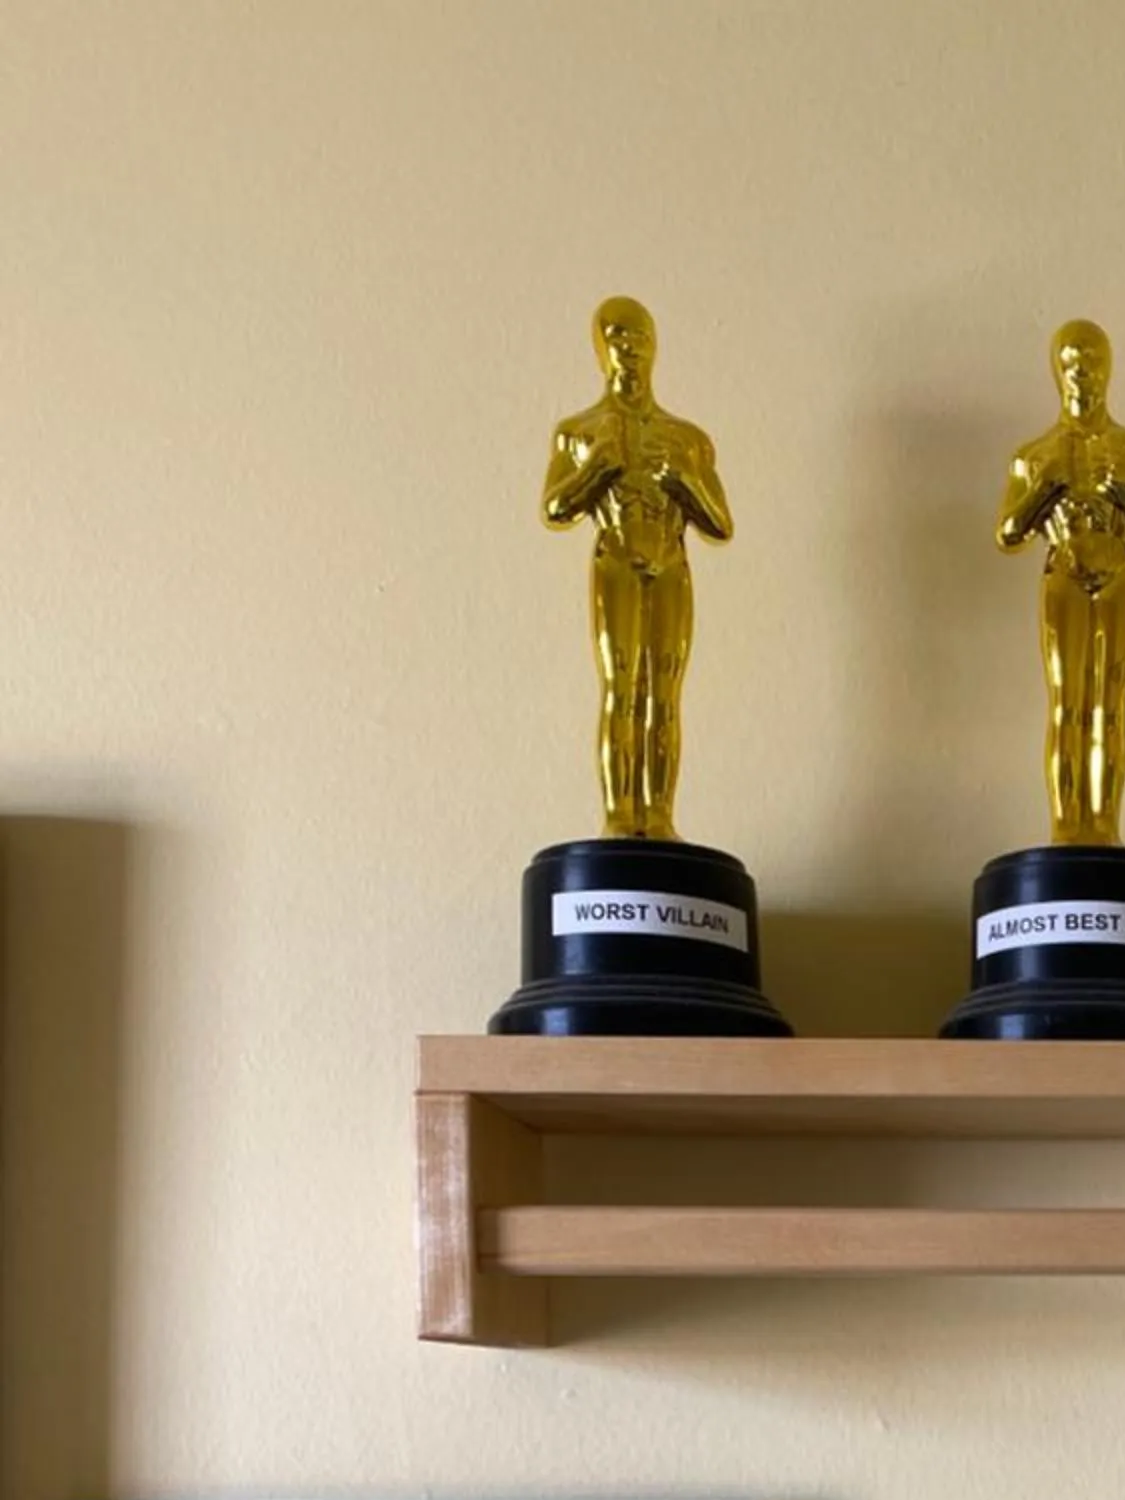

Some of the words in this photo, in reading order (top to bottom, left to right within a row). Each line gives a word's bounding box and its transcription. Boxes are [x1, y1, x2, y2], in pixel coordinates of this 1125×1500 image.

[575, 902, 649, 922] WORST
[656, 904, 729, 934] VILLAIN
[988, 914, 1058, 941] ALMOST
[1065, 912, 1121, 931] BEST
